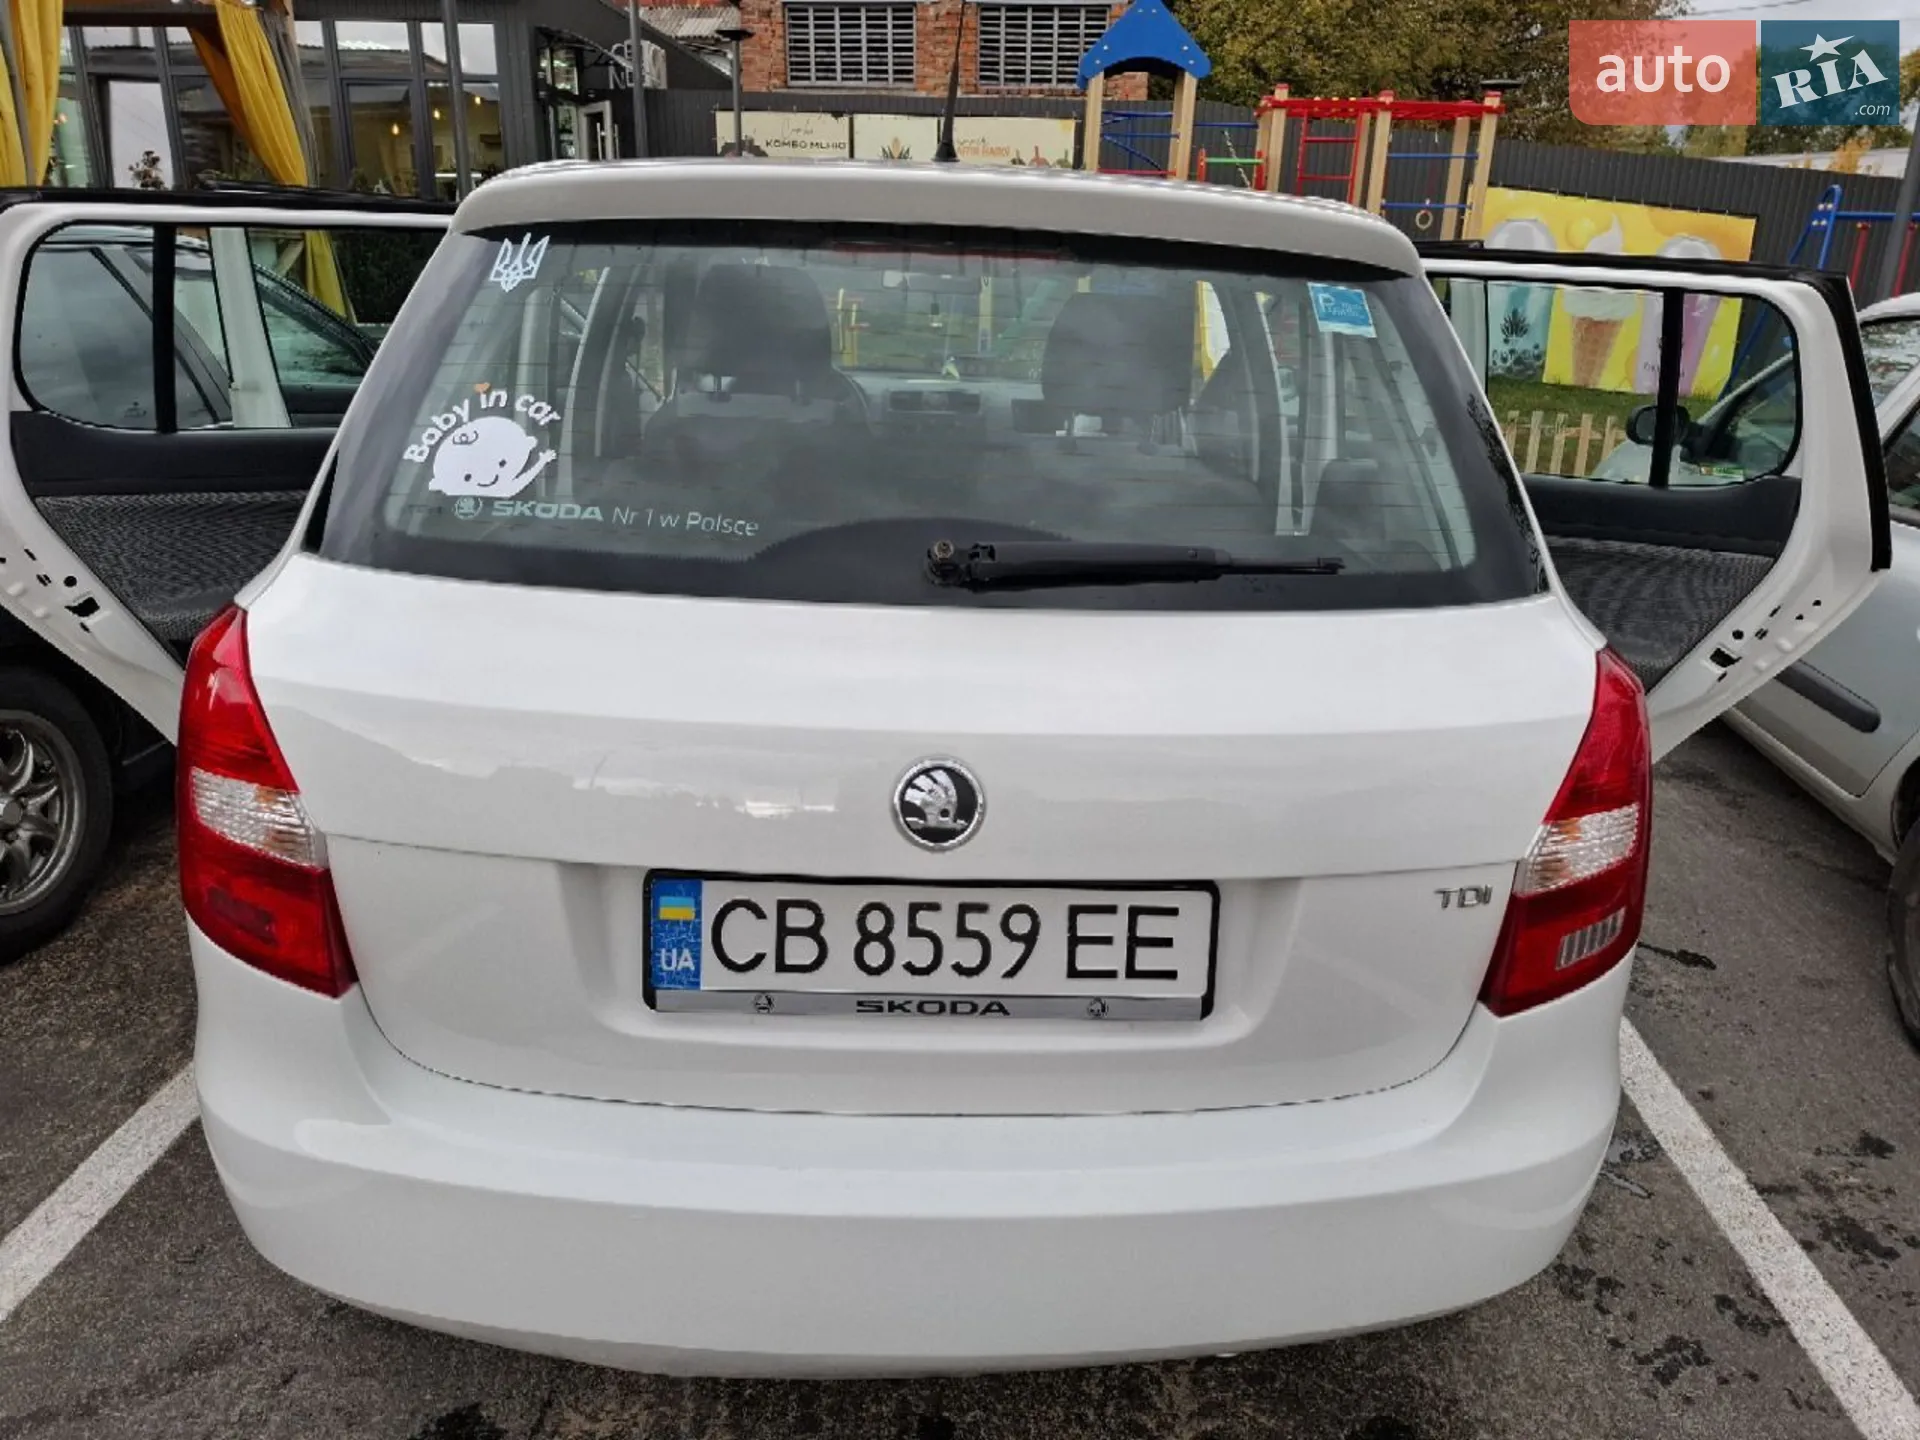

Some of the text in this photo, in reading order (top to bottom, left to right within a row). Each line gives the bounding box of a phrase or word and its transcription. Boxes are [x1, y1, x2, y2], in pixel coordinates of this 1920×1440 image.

[403, 389, 562, 463] Baby in car
[612, 507, 637, 526] Nr
[659, 516, 680, 529] w
[685, 515, 760, 537] Polsce
[1434, 884, 1493, 909] TDI
[853, 901, 1041, 978] 8559
[1066, 904, 1180, 980] EE
[660, 947, 696, 972] UA
